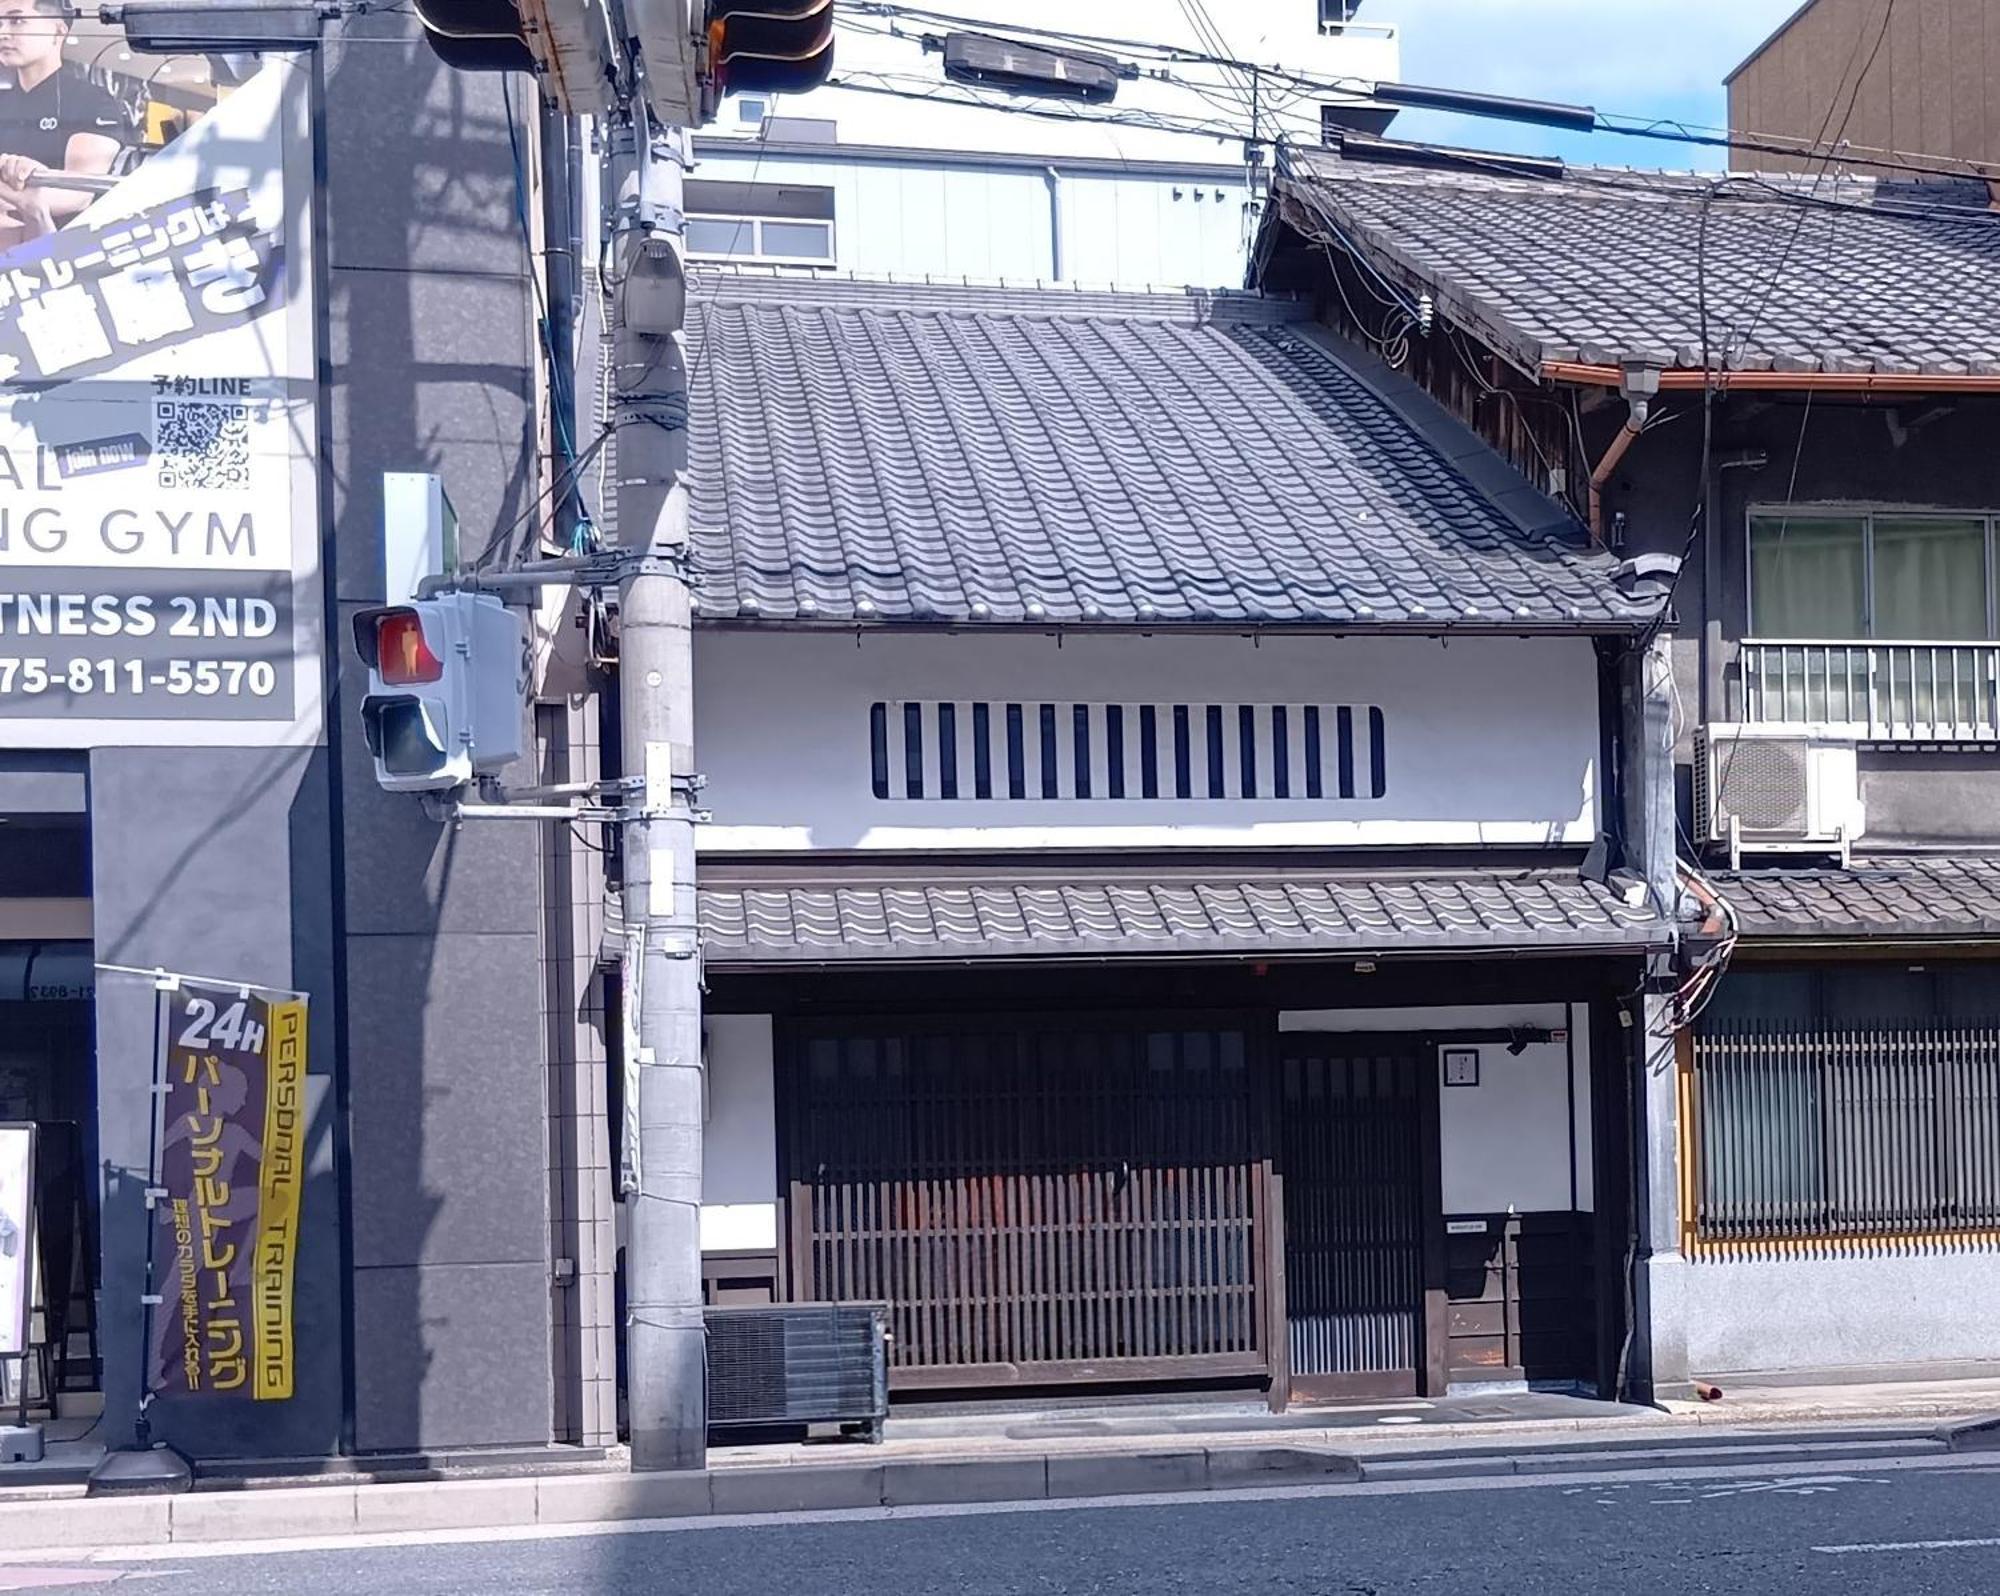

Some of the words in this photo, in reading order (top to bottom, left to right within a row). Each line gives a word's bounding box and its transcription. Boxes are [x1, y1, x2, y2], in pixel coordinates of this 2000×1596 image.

[151, 374, 252, 396] 予約LINE
[67, 445, 98, 474] join
[99, 442, 136, 465] now
[100, 508, 256, 557] GYM
[169, 597, 277, 638] 2ND
[178, 998, 265, 1054] 24H
[184, 1055, 247, 1389] パーソナルトレーニング
